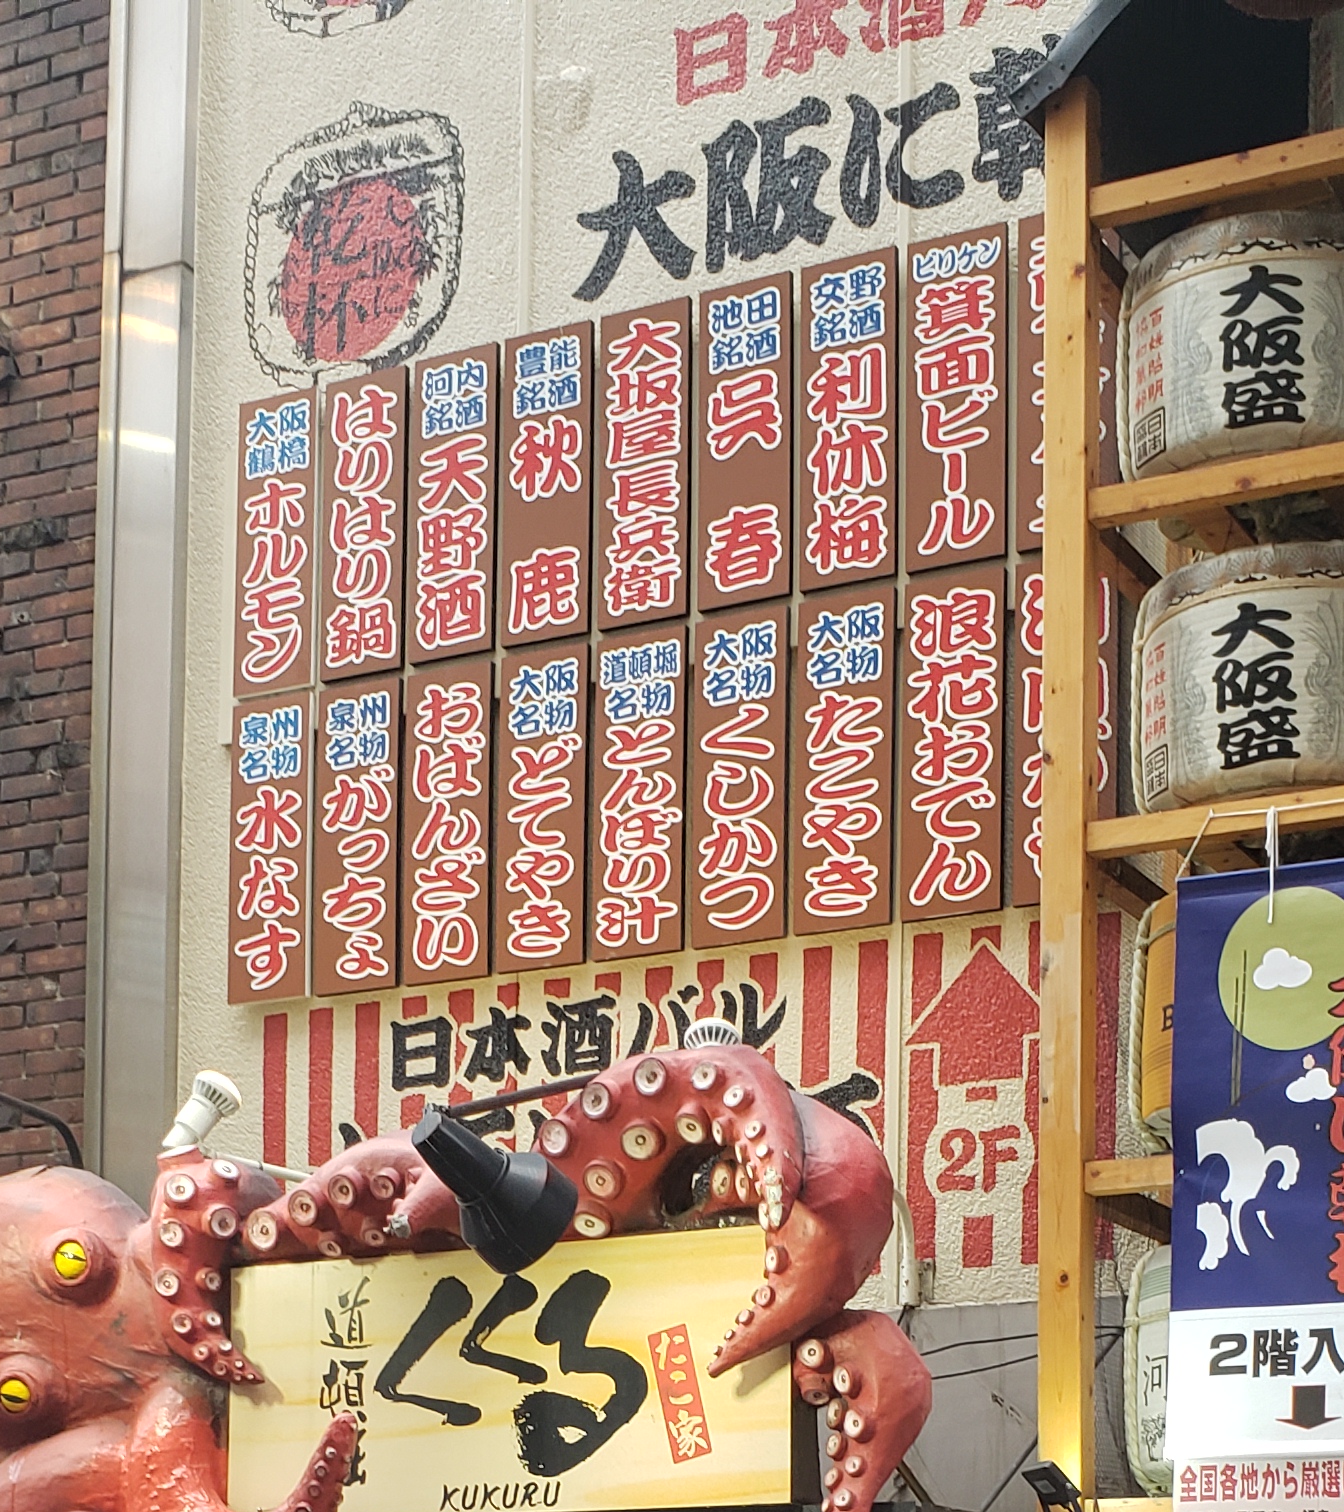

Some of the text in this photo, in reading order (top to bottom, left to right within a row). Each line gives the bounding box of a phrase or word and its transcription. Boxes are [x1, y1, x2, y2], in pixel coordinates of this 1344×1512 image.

[912, 237, 1001, 283] ビリケン
[708, 287, 781, 331] 池田
[810, 262, 885, 309] 交野
[708, 326, 779, 371] 銘酒
[808, 302, 884, 348] 銘酒
[1219, 265, 1305, 429] 大阪盛
[423, 360, 487, 401] 河内
[516, 337, 580, 377] 豊能
[423, 393, 485, 436] 銘酒
[515, 372, 578, 416] 銘酒
[914, 273, 999, 556] 箕面ビール
[246, 400, 309, 443] 大阪
[804, 342, 889, 575] 利休梅
[325, 383, 395, 670] はりはり鍋
[416, 430, 488, 648] 天野酒
[241, 482, 309, 682] ホルモン
[703, 621, 777, 666] 大阪
[808, 602, 885, 650] 大阪
[511, 656, 578, 703] 大阪
[599, 638, 682, 688] 道頓堀
[702, 661, 777, 706] 名物
[806, 641, 884, 687] 名物
[1212, 602, 1301, 770] 大阪盛
[325, 693, 390, 736] 泉州
[508, 695, 578, 740] 名物
[604, 673, 676, 721] 名物
[239, 704, 300, 745] 泉州
[906, 586, 999, 908] 浪花おでん
[238, 741, 301, 782] 名物
[324, 728, 389, 770] 名物
[412, 680, 483, 970] おばんざい
[698, 704, 780, 932] くしかつ
[800, 687, 887, 920] たこやき
[501, 736, 583, 958] どてやき
[594, 717, 682, 949] とんぼり汁
[233, 784, 303, 990] 水なす
[319, 762, 395, 982] がっちょ
[939, 1127, 1023, 1194] 2F
[374, 1270, 648, 1477] くくる
[439, 1481, 560, 1511] KUKURU
